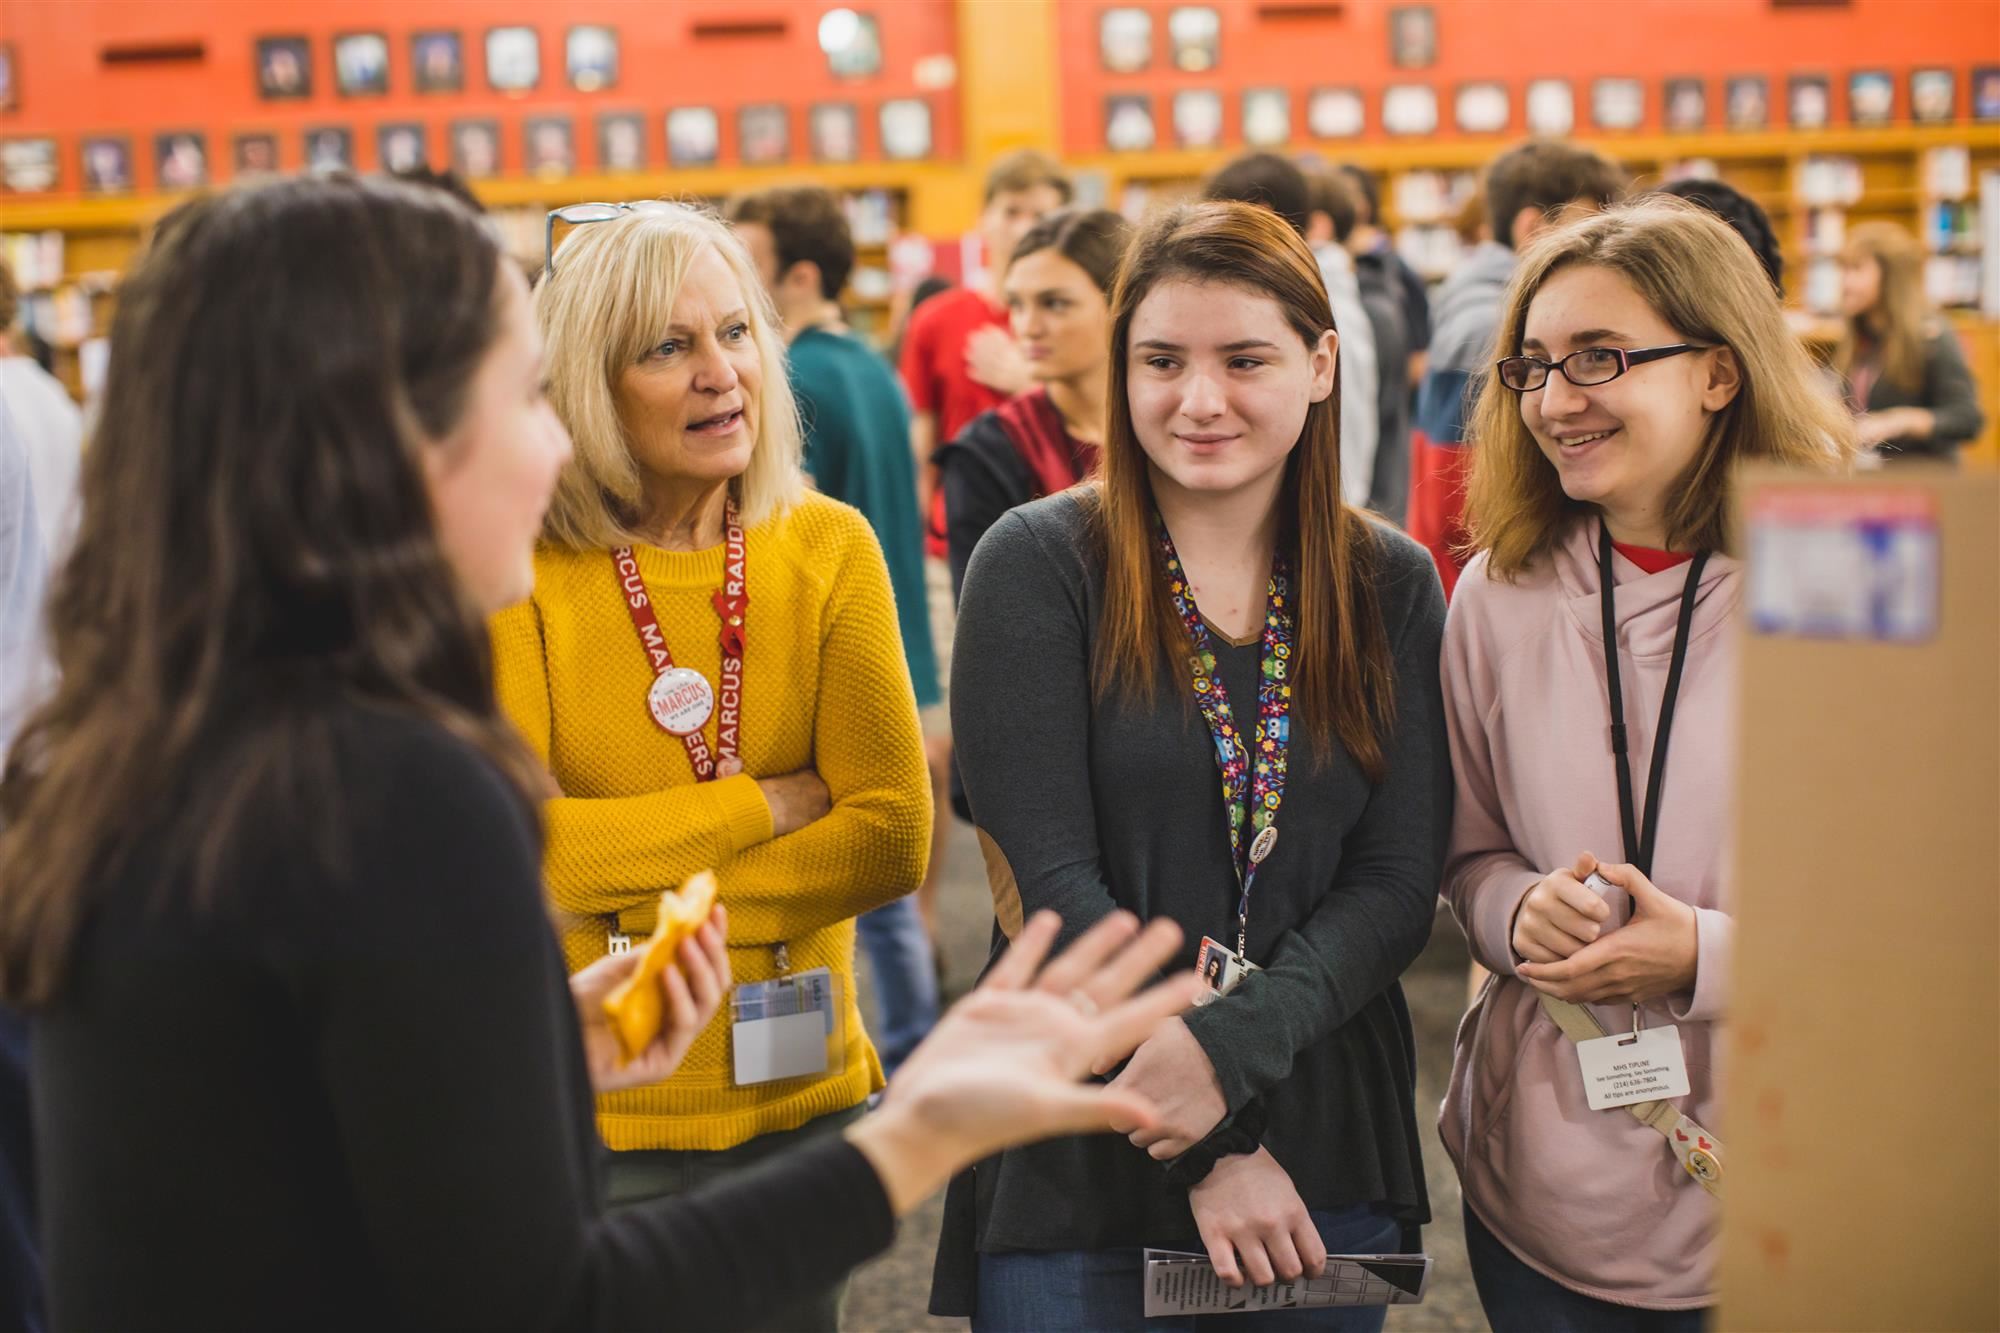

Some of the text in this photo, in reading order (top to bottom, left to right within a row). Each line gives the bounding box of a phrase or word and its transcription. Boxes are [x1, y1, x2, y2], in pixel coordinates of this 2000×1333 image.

[615, 545, 648, 609] RCUS
[657, 682, 706, 717] MARCUS
[1613, 1060, 1650, 1071] MHS TIPLINE
